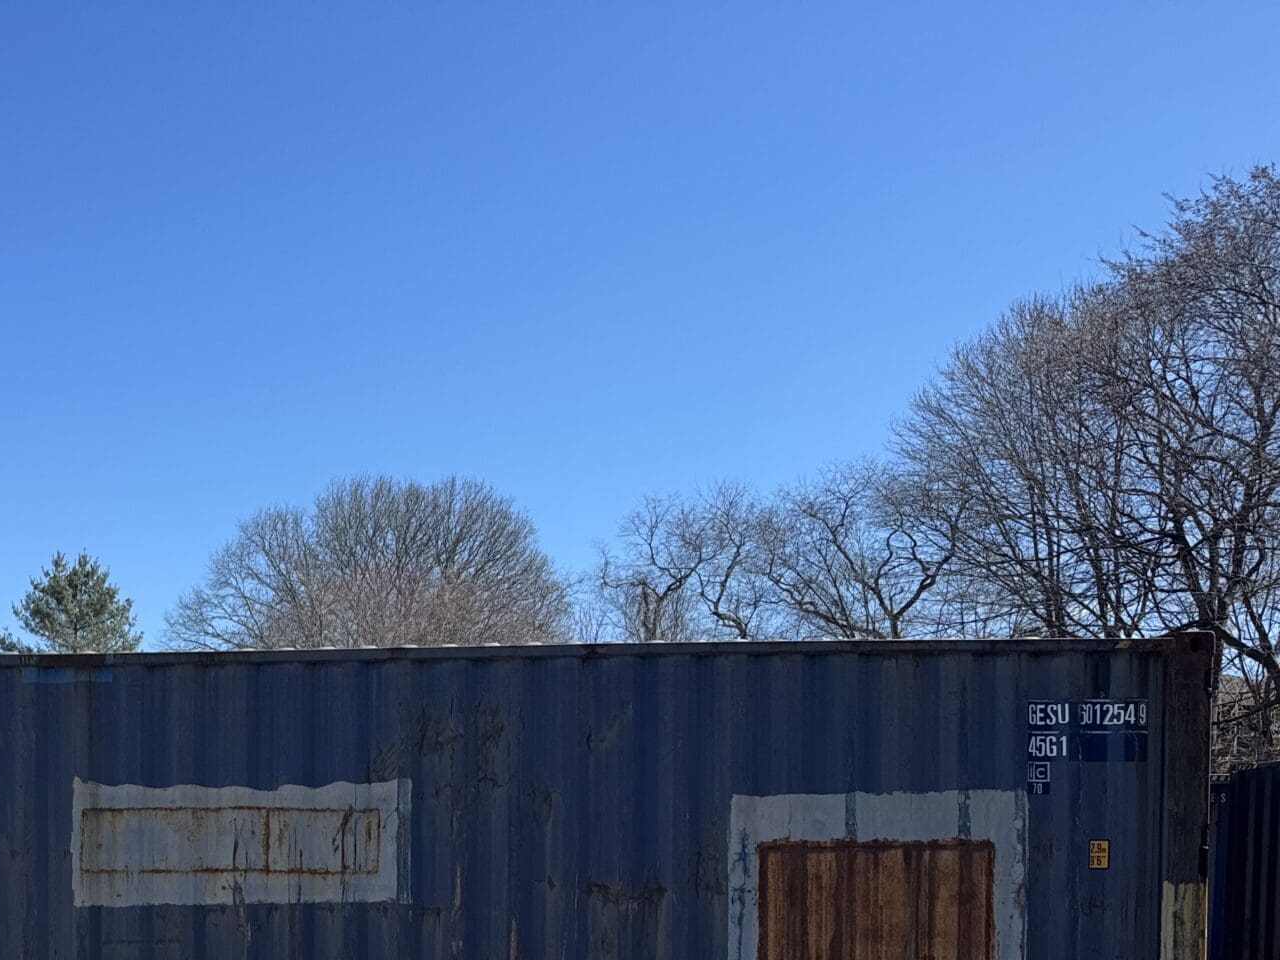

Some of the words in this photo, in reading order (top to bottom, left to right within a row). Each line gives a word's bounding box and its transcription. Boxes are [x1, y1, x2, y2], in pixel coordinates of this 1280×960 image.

[1028, 703, 1070, 725] GESU
[1138, 703, 1147, 725] 9
[1028, 735, 1068, 757] 45G1
[1032, 782, 1043, 795] 70
